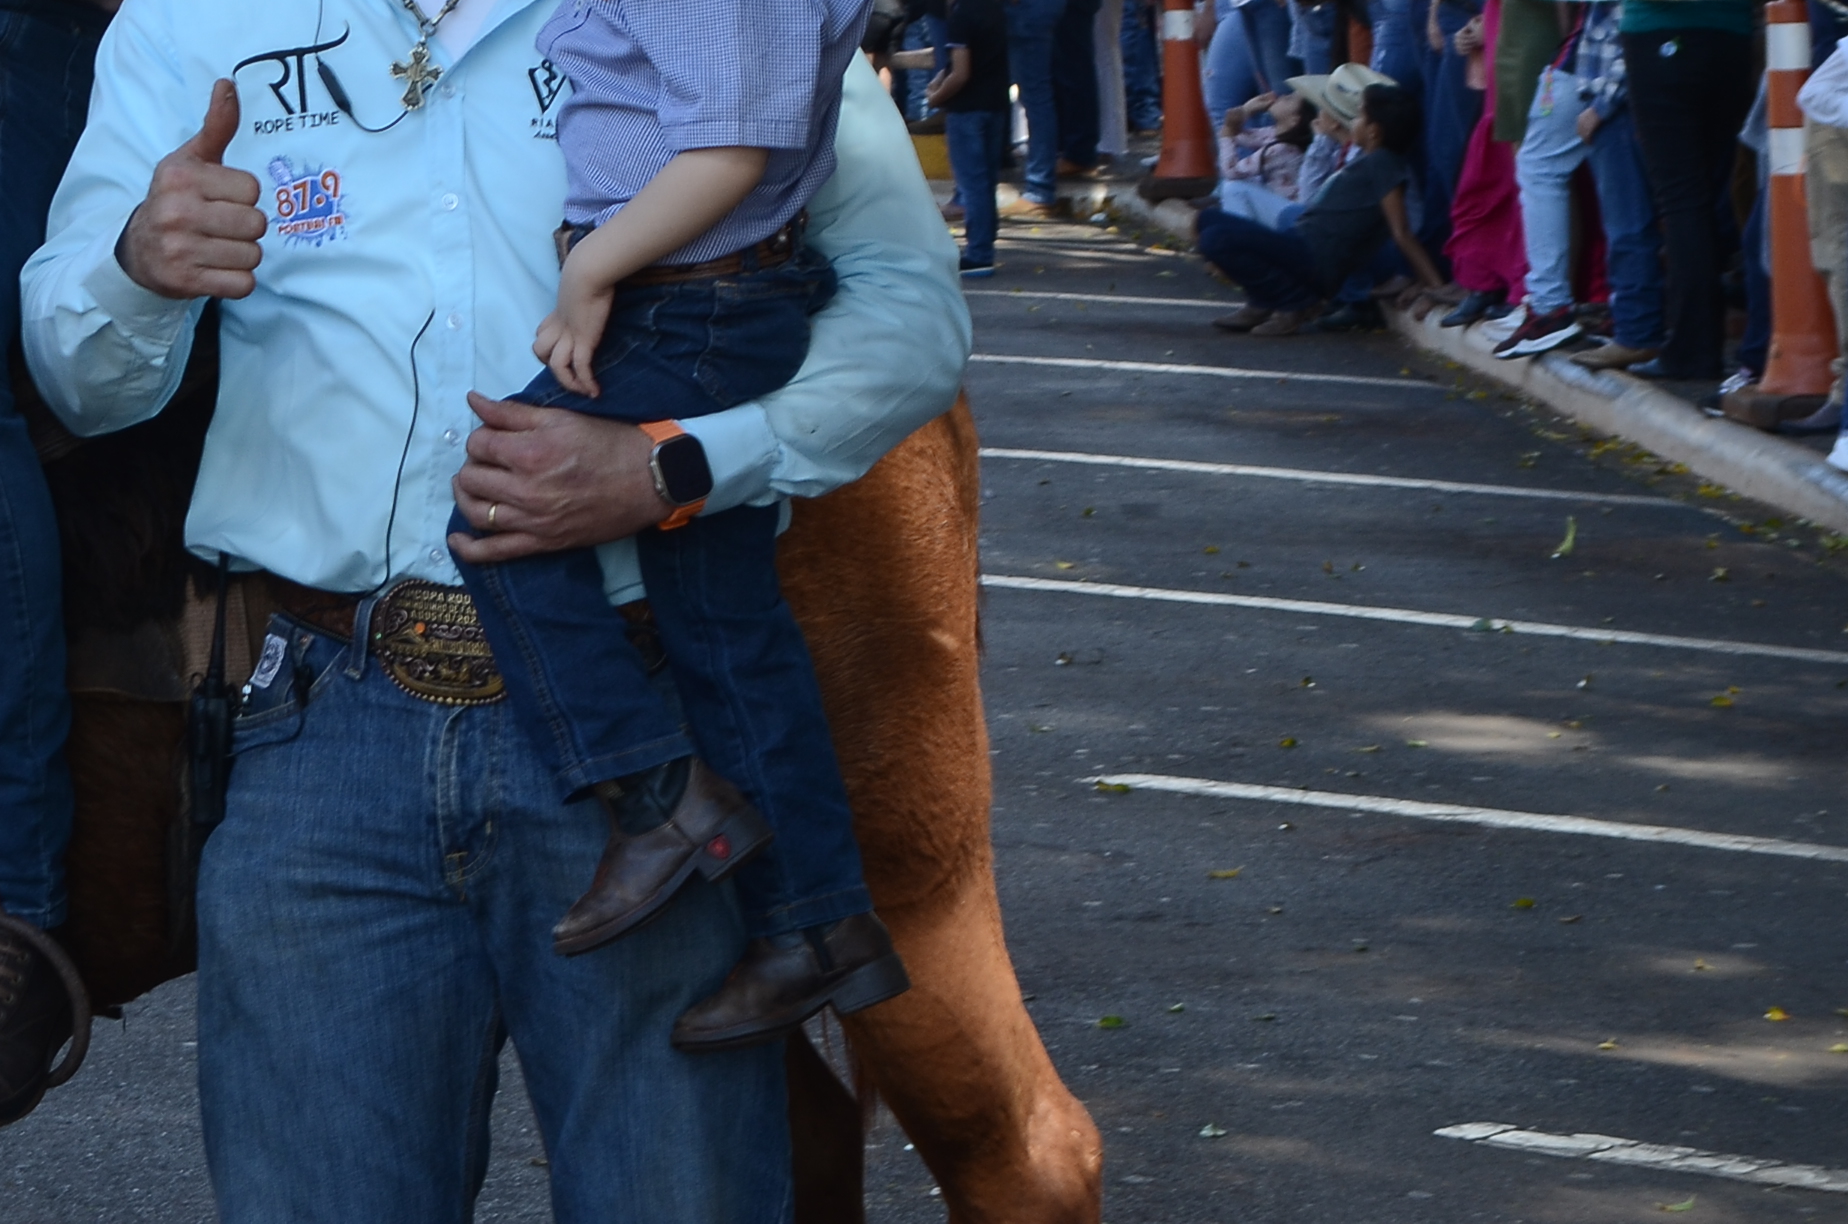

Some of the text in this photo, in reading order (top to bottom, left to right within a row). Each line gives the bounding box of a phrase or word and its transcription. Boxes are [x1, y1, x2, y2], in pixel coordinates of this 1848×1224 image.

[254, 111, 340, 135] ROPE TIME
[276, 169, 341, 218] 87.9
[414, 589, 445, 602] COPA
[447, 593, 474, 605] 200
[410, 609, 480, 626] AGOSTO/202
